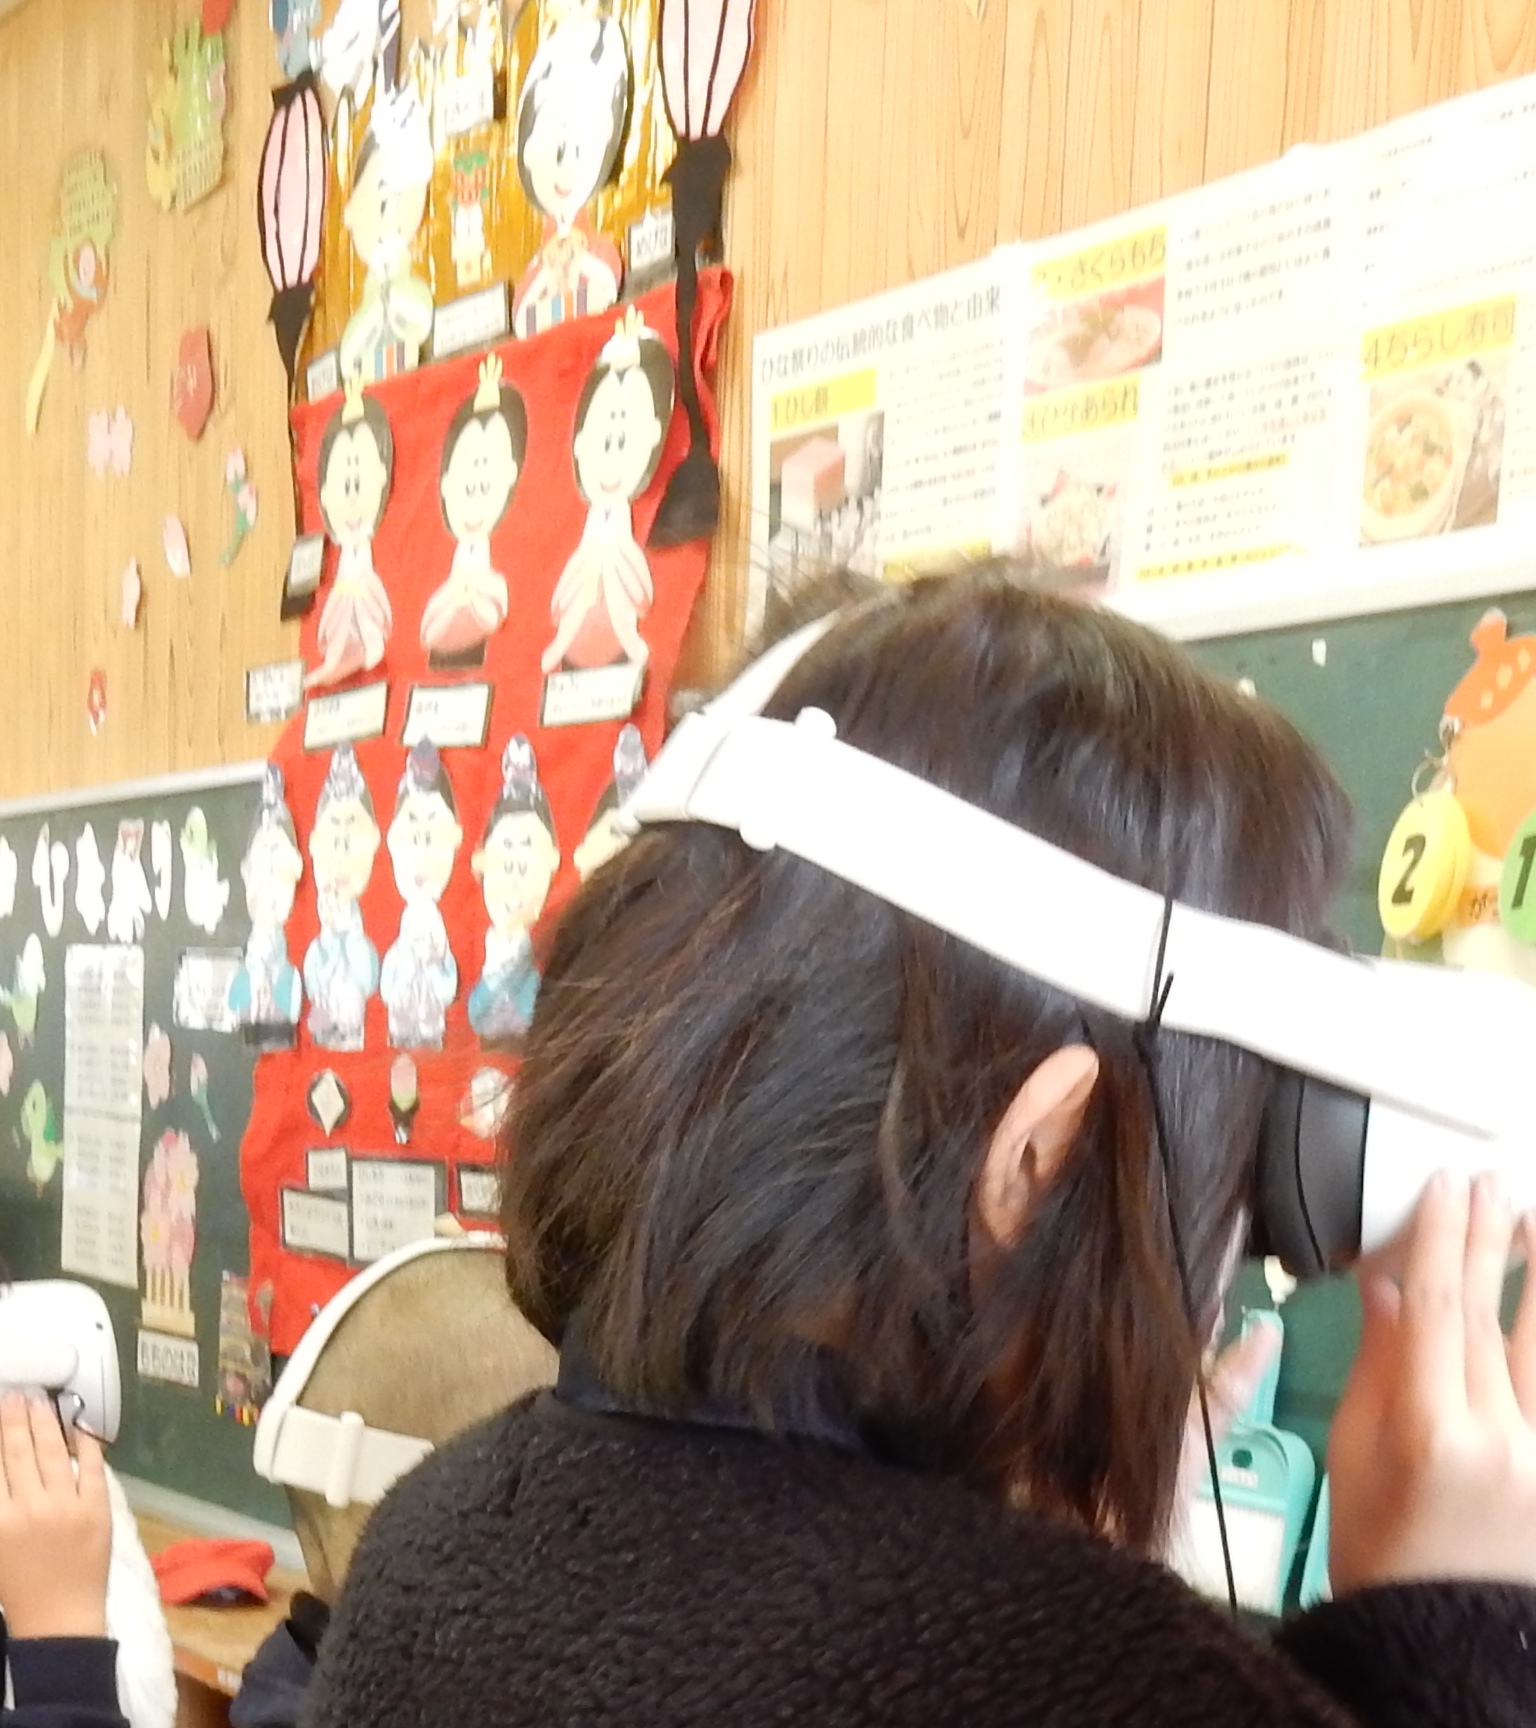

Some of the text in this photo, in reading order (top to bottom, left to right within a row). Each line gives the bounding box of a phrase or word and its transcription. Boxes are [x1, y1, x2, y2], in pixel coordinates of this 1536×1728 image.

[761, 284, 1001, 385] ひな祭りの伝統的な食べ物と由来
[1391, 834, 1426, 906] 2
